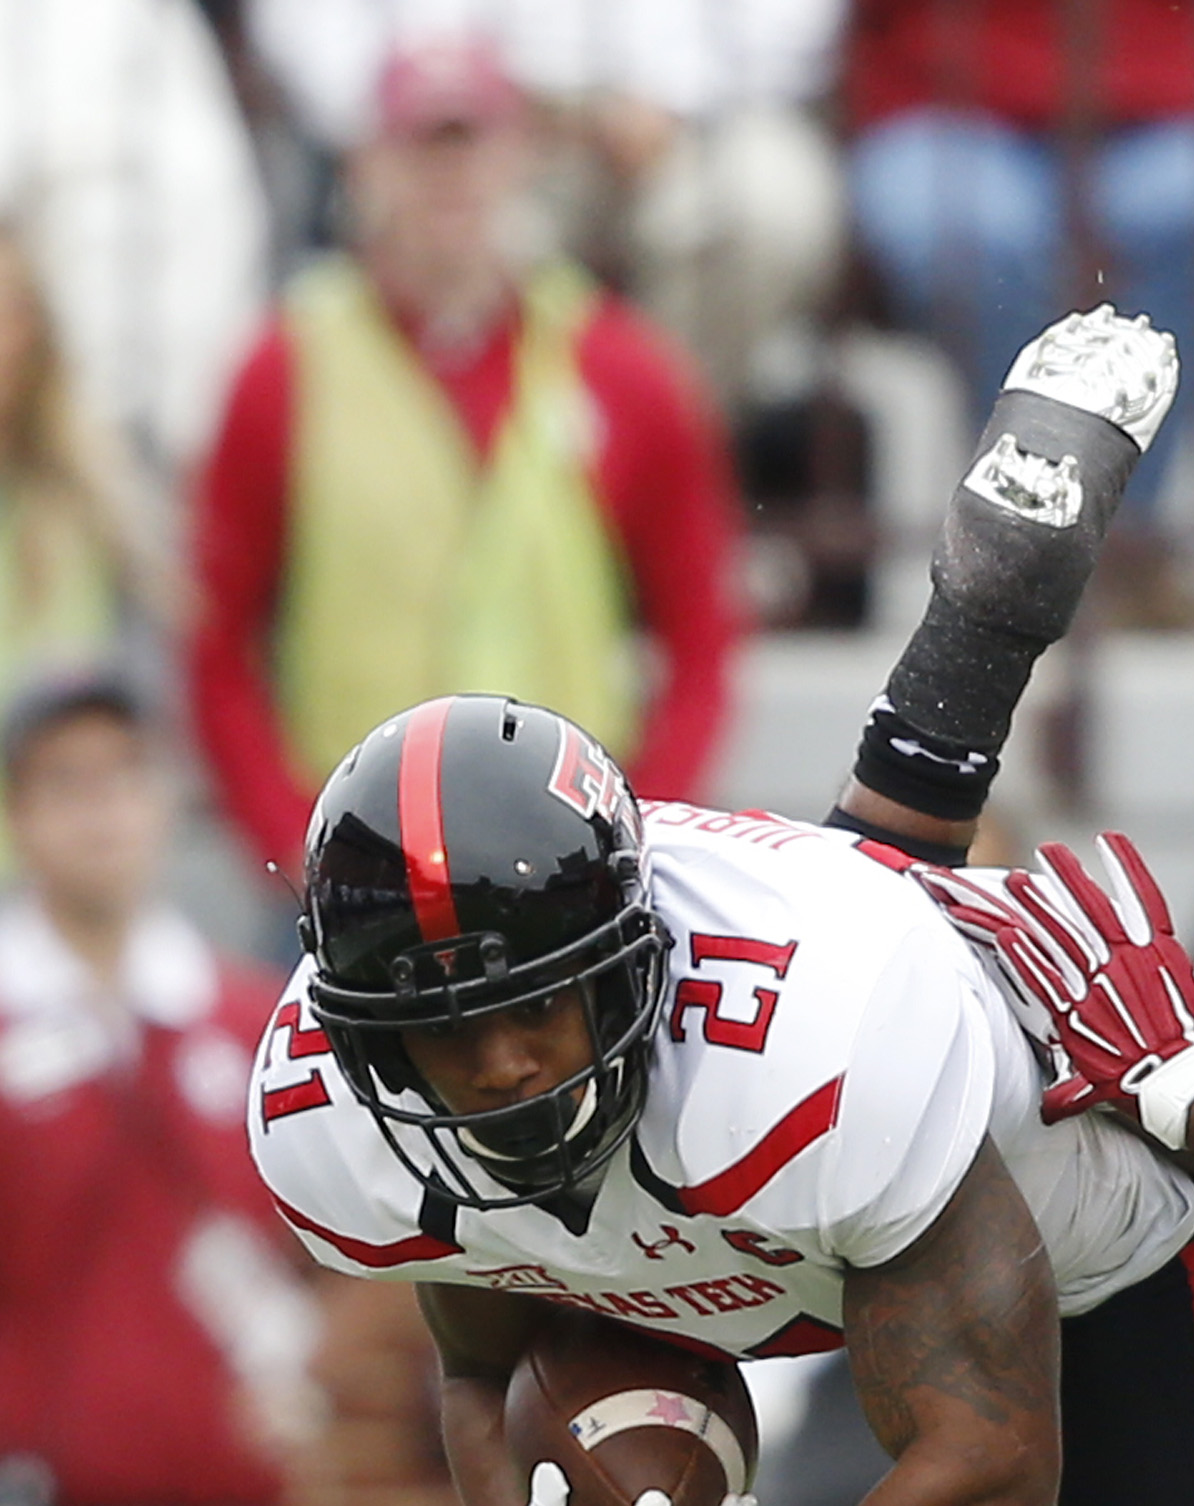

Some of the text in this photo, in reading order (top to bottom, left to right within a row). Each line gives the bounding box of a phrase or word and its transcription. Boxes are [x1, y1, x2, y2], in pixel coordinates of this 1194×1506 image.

[669, 930, 799, 1055] 21
[261, 998, 334, 1136] 21
[720, 1228, 805, 1267] C
[713, 1273, 787, 1316] TECH
